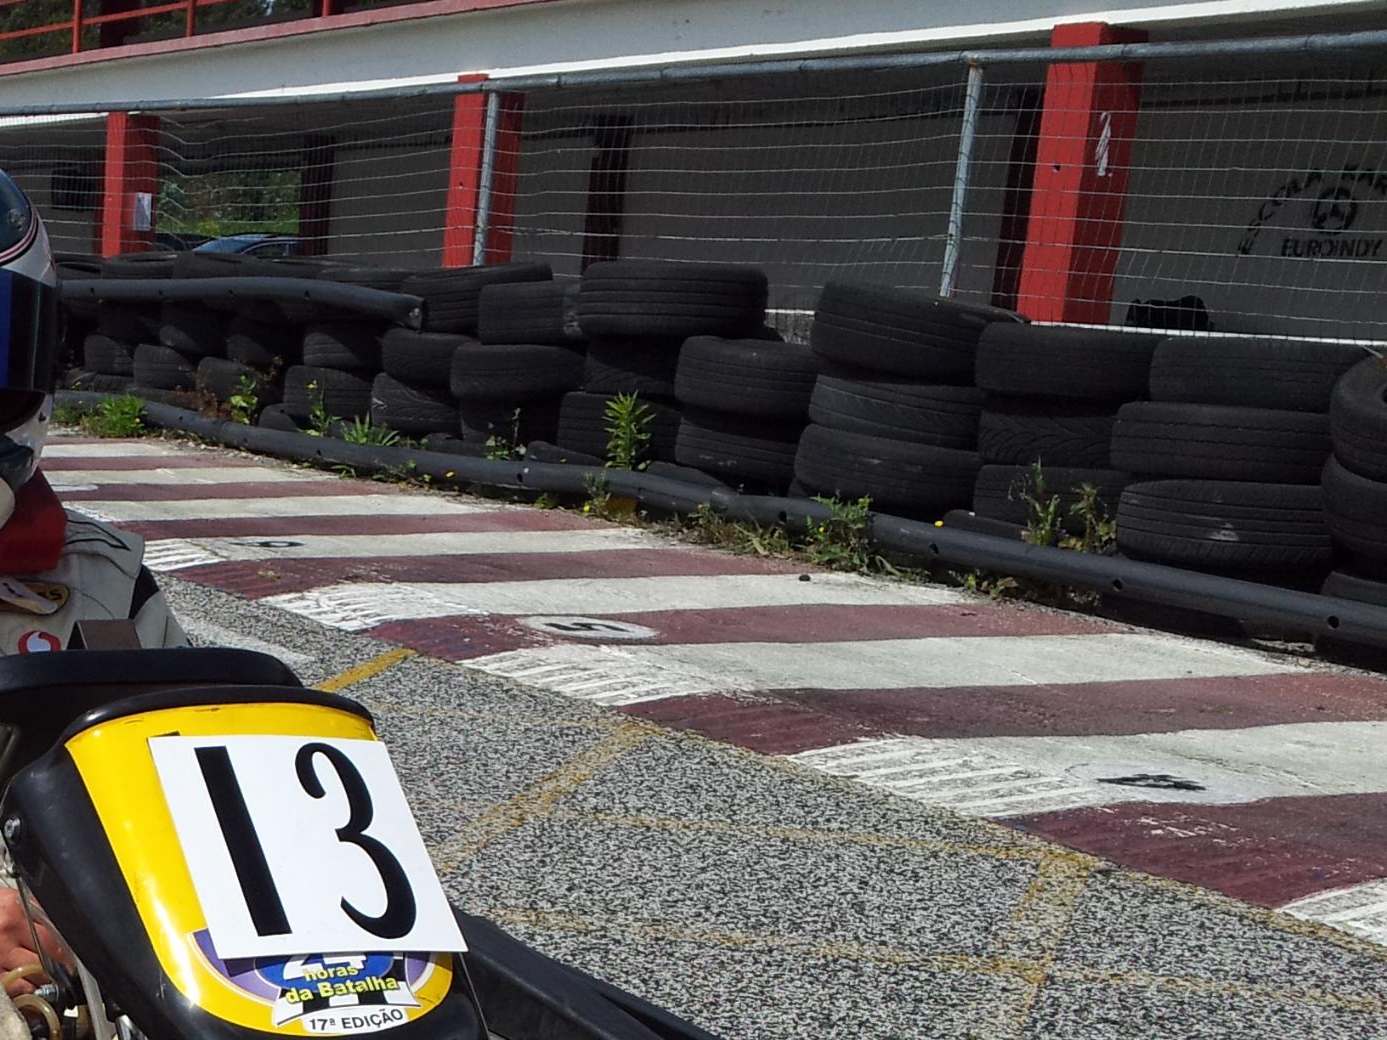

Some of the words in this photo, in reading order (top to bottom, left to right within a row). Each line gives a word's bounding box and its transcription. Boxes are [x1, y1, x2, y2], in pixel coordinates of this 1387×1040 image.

[1282, 238, 1383, 257] EUROINDY
[193, 742, 417, 940] 13
[303, 965, 360, 981] horas
[284, 987, 314, 1004] da
[317, 976, 399, 998] Batalha
[341, 1008, 404, 1029] EDIÇÃO
